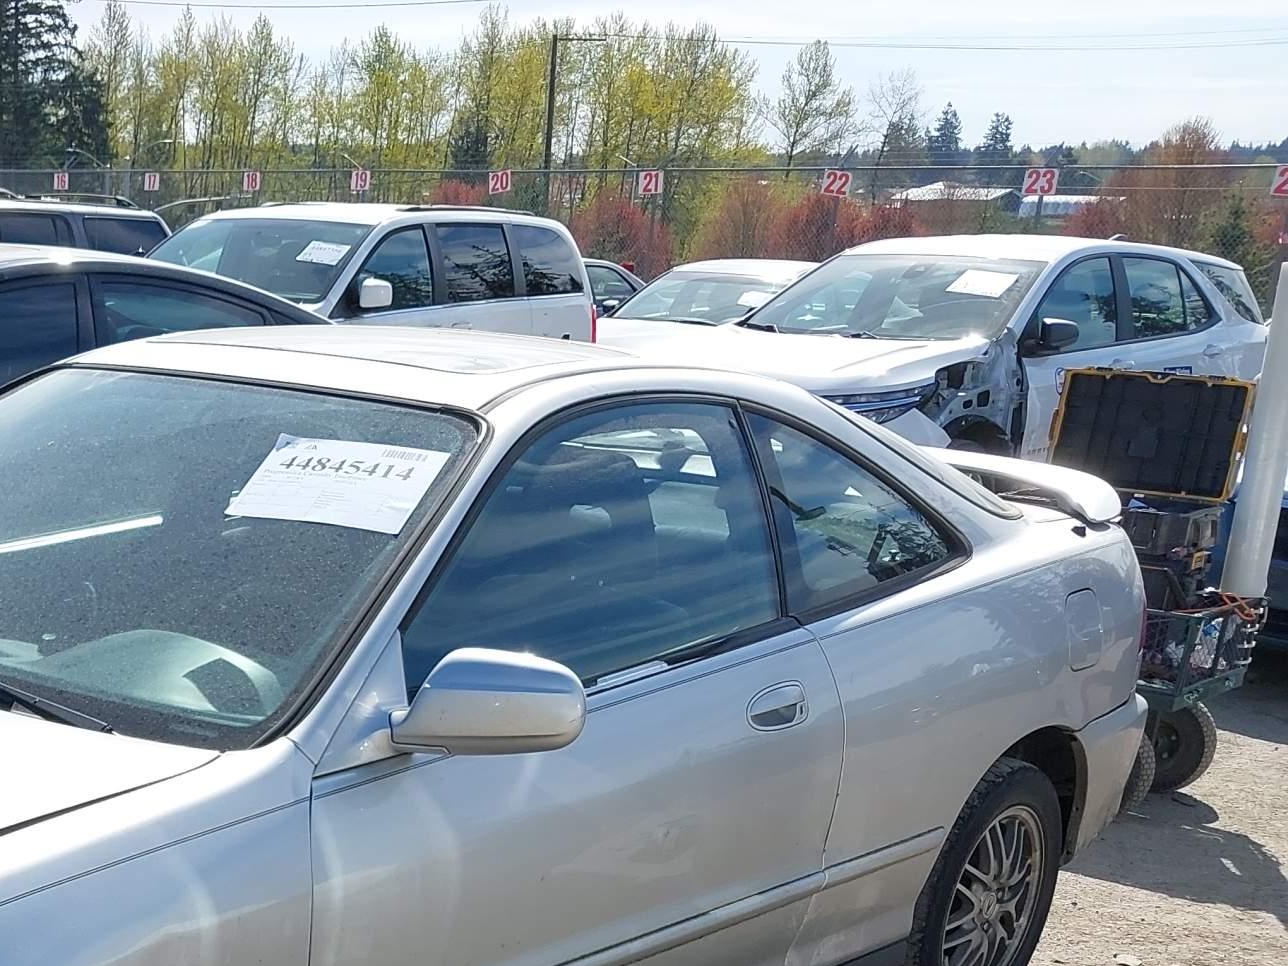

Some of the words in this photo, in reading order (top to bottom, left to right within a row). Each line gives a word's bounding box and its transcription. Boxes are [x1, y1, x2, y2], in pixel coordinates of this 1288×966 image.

[56, 174, 66, 189] 16
[148, 174, 157, 189] 17
[246, 172, 257, 189] 18
[354, 171, 368, 189] 19
[491, 171, 509, 193] 20
[642, 172, 659, 193] 21
[824, 171, 850, 196] 22
[1024, 169, 1056, 194] 23
[279, 456, 415, 481] 44845414
